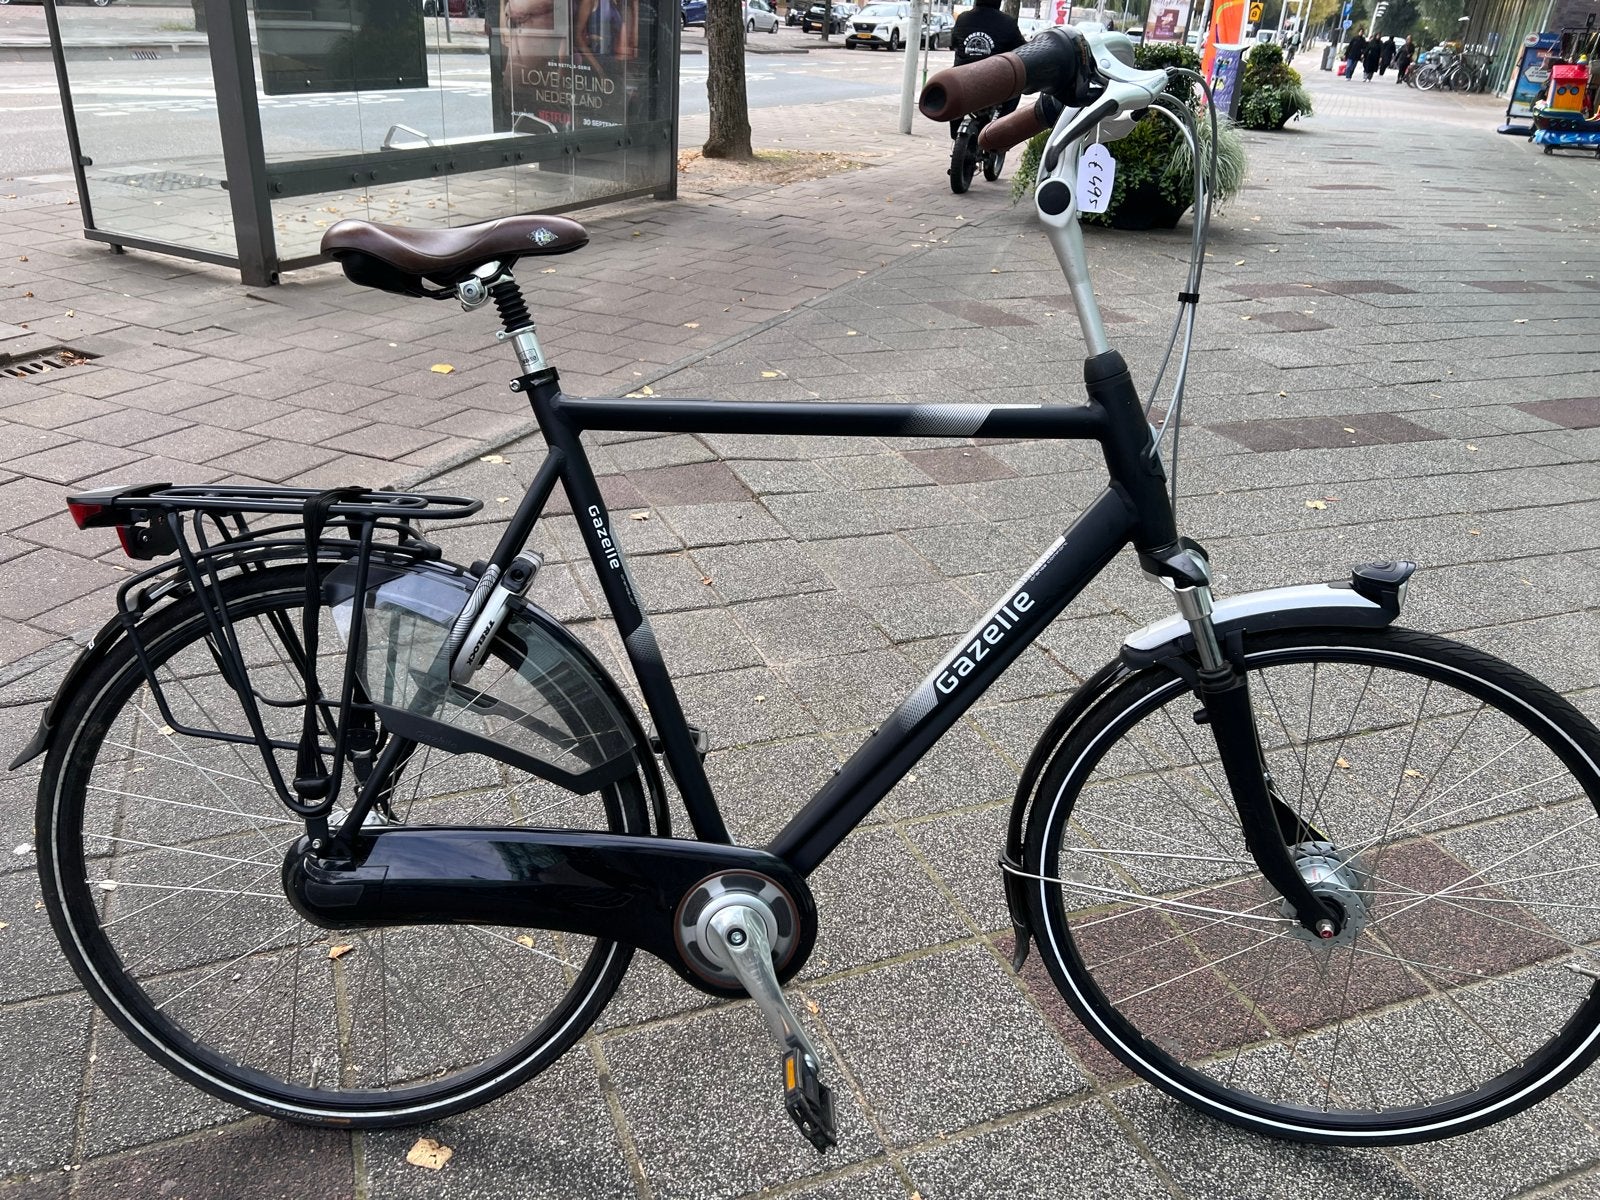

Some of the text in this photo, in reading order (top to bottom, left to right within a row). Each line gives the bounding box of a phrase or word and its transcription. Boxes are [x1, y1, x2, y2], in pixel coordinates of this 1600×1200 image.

[558, 63, 591, 71] NETFLX-SERIE
[521, 69, 615, 95] LOVE IS BLIND
[535, 89, 603, 109] NEDERLAND
[582, 118, 623, 128] 30 SEPTEM
[1087, 175, 1103, 209] 495
[588, 504, 620, 570] Gazelle
[466, 619, 496, 666] TRELOCK
[935, 591, 1036, 695] Gazelle
[271, 1108, 323, 1122] CONTACT
